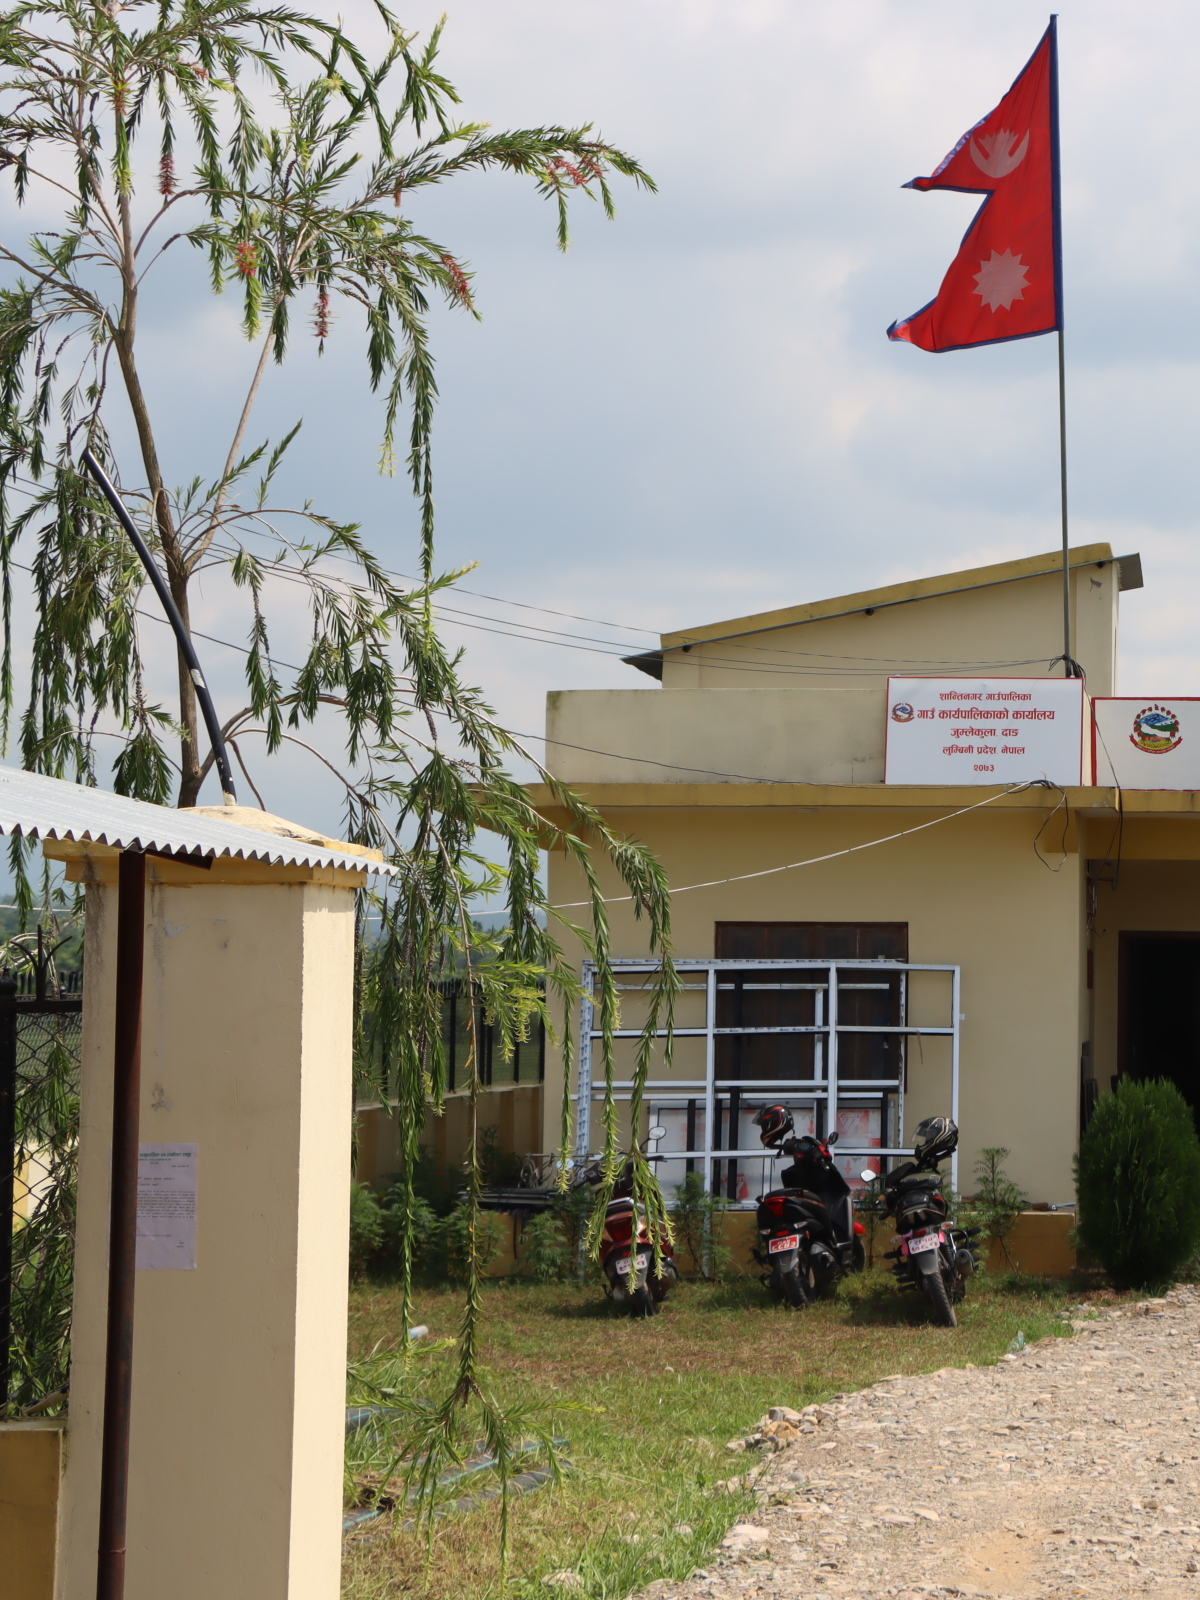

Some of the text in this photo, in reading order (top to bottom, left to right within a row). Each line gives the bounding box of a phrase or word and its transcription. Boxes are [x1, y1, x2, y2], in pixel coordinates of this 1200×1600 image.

[939, 690, 1032, 702] शान्तिनगर गाउँपालिका
[917, 707, 1056, 720] गाउँ कार्यपालिकाको कार्यालय
[1001, 745, 1026, 755] नेपाल
[973, 764, 995, 773] २०७३
